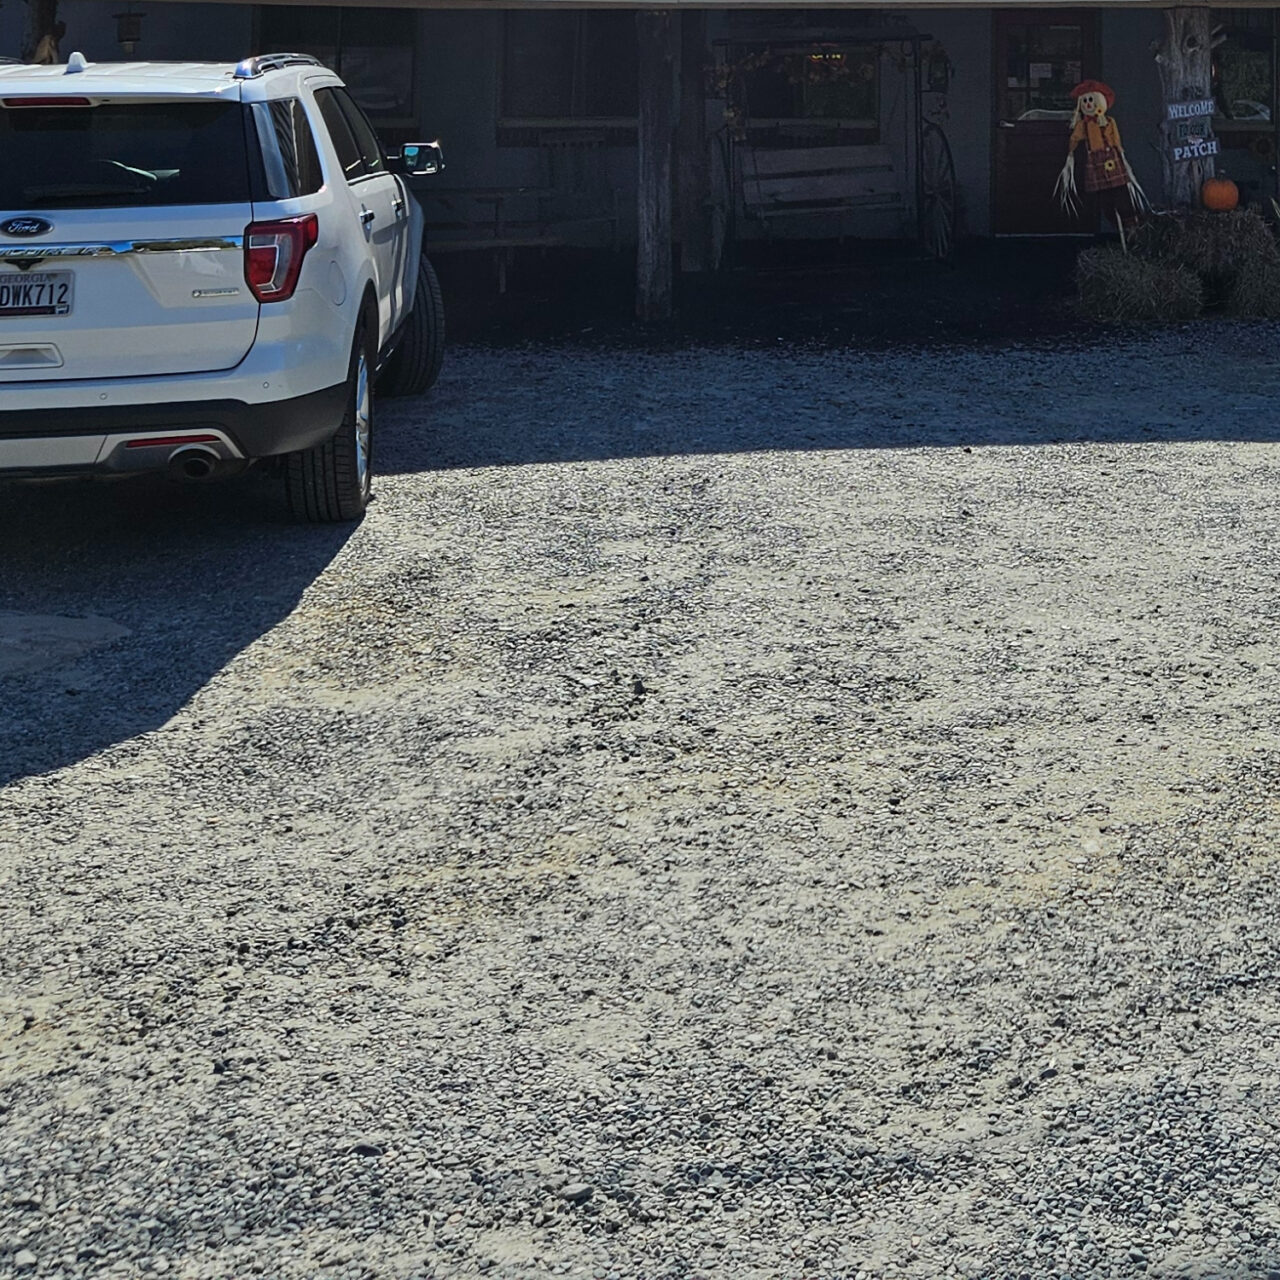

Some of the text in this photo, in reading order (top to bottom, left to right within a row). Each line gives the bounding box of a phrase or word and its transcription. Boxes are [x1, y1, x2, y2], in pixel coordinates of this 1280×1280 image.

[1168, 99, 1215, 119] WELCOME
[1173, 141, 1218, 161] PATCH
[8, 220, 40, 233] Ford
